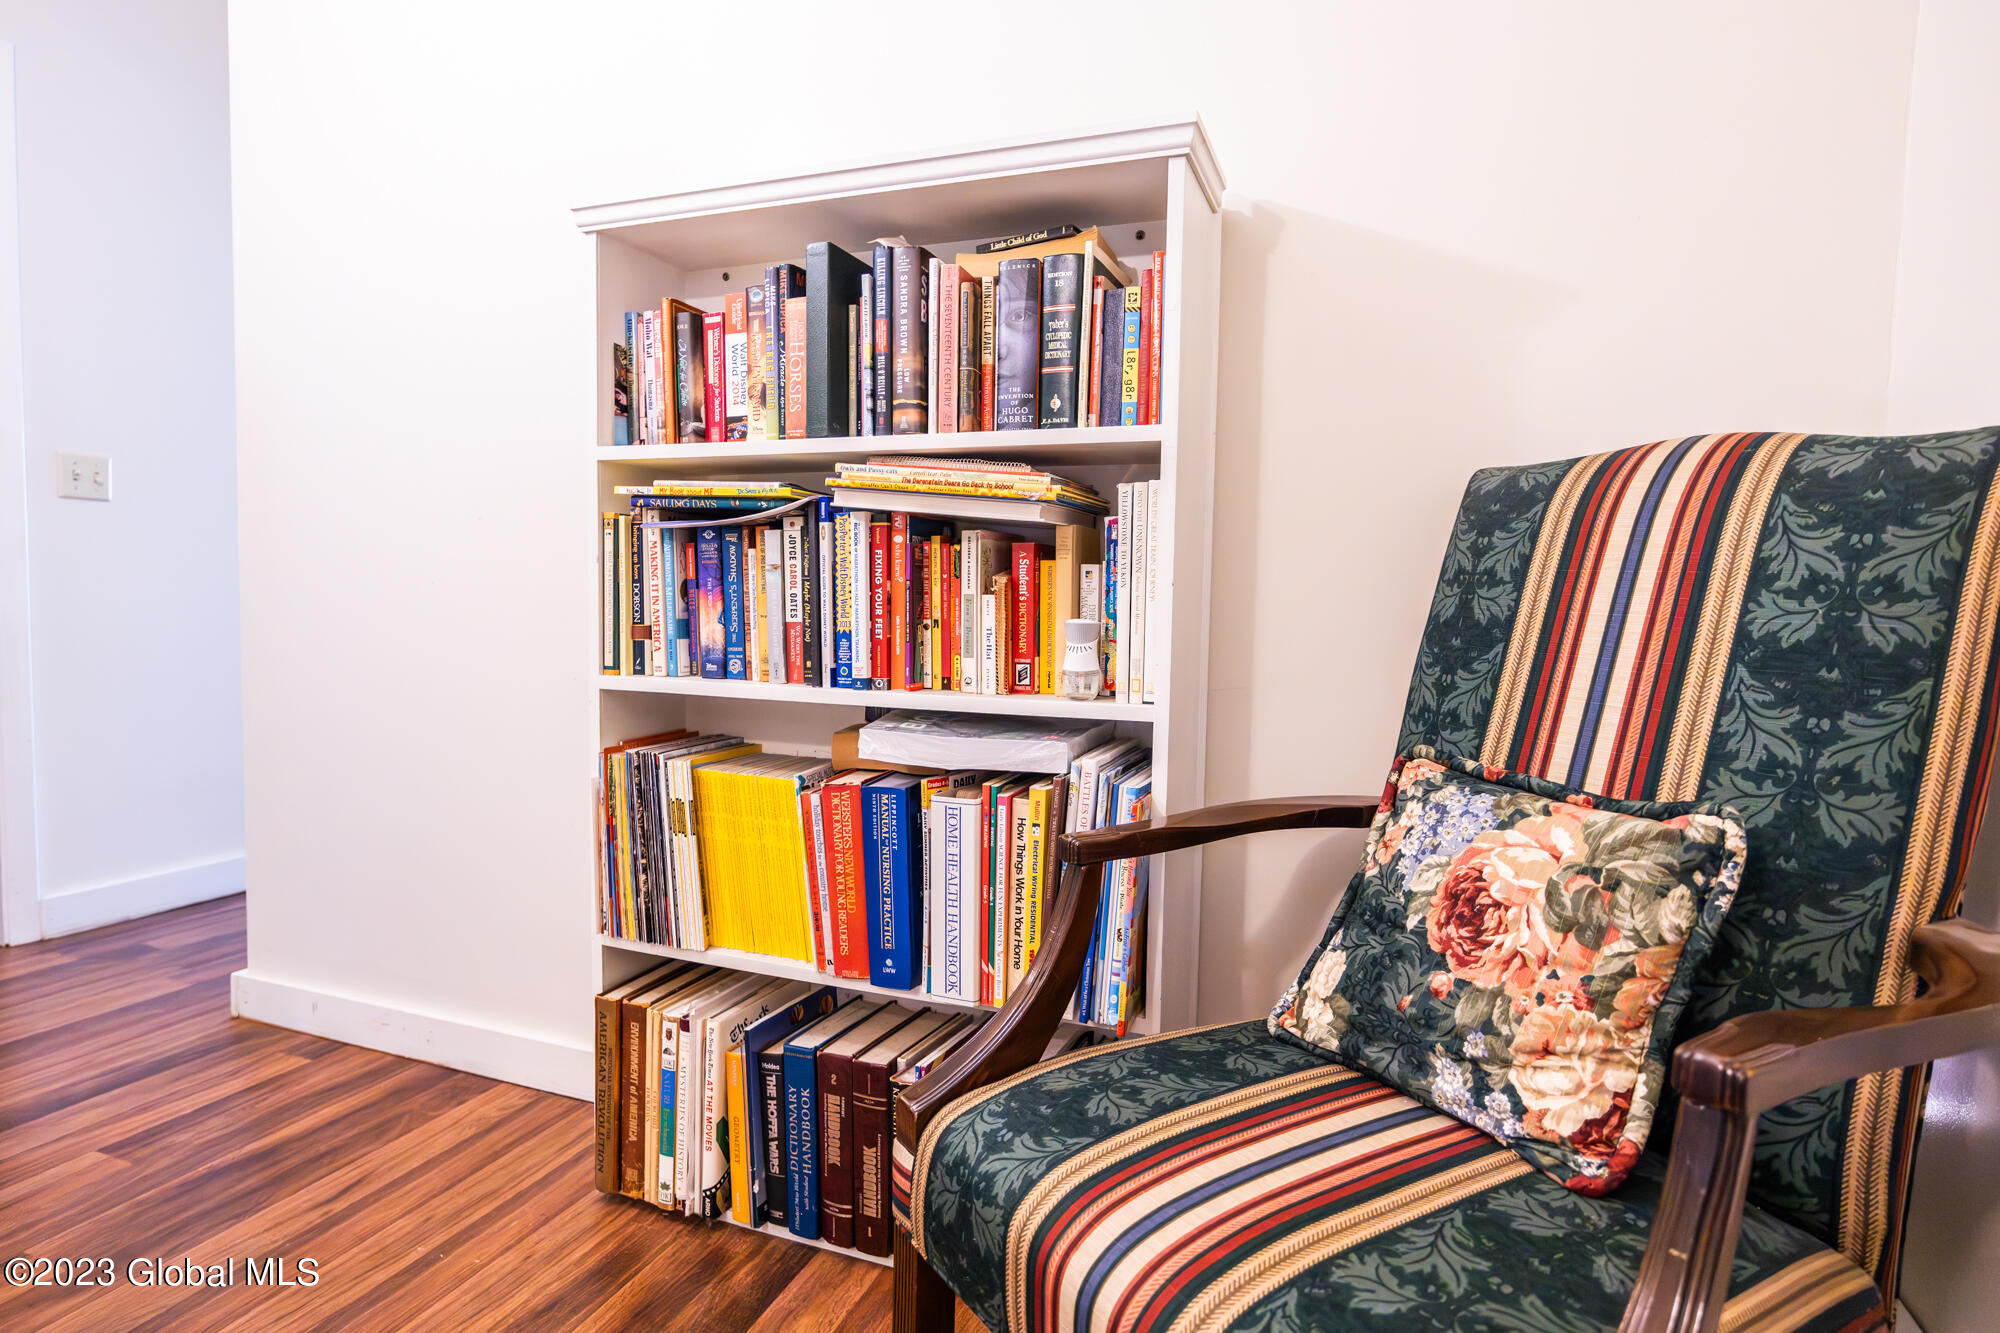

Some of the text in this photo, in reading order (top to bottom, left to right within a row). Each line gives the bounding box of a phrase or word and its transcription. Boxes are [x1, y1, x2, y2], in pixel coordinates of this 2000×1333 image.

[1007, 235, 1025, 246] Child
[1026, 233, 1032, 241] of
[1033, 230, 1047, 240] God
[878, 257, 887, 286] KILLING
[878, 287, 887, 316] LINCOLN
[900, 275, 908, 355] SANDRA BROWN
[983, 281, 993, 356] THINGS FALL APART
[766, 324, 776, 410] THE BIG FIELD
[878, 356, 886, 369] BILL
[943, 284, 953, 408] THE SEVENTEENTH CENTURY
[713, 356, 721, 387] Dictionary
[731, 343, 739, 406] World 2014
[739, 342, 748, 406] Walt Disney
[789, 342, 804, 414] HORSES
[878, 370, 886, 395] O'REILLY
[998, 415, 1034, 424] CABRET
[1002, 407, 1028, 415] HUGO
[650, 499, 718, 508] SAILING DAYS
[704, 488, 714, 496] ME
[912, 478, 943, 486] Berenstain
[944, 479, 960, 487] Bears
[994, 482, 1014, 490] School
[632, 525, 640, 580] bringing up boys
[728, 545, 737, 582] SHADOW
[1120, 491, 1129, 588] YELLOWSTONE TO YUKON
[1135, 524, 1143, 573] UNKNOWN
[789, 535, 798, 619] JOYCE CAROL OATES
[838, 518, 850, 619] PassPorter's Walt Disney World
[1019, 559, 1030, 601] Student's
[633, 582, 641, 623] DOBSON
[650, 540, 662, 653] MAKING IT IN AMERICA
[729, 585, 738, 632] SERPENT'S
[804, 602, 812, 626] (Maybe
[874, 549, 883, 640] FIXING YOUR FEET
[804, 627, 812, 643] Not)
[1018, 603, 1027, 655] DICTIONARY
[953, 774, 976, 789] DAILY
[1080, 772, 1093, 831] BATTLES OF
[813, 805, 823, 828] holiday
[880, 794, 890, 839] MANUAL
[815, 829, 824, 854] touches
[841, 790, 857, 913] WEBSTER'S NEW WORLD
[1031, 840, 1039, 873] Electrical
[818, 868, 828, 893] country
[831, 792, 849, 956] DICTIONARY FOR YOUNG READERS
[881, 845, 891, 895] NURSING
[1013, 818, 1026, 970] How Things Work in Your Home
[1030, 875, 1038, 899] Wiring
[883, 897, 893, 949] PRACTICE
[947, 806, 959, 994] HOME HEALTH HANDBOOK
[1029, 900, 1037, 944] RESIDENTIAL
[882, 966, 896, 974] LWW
[597, 1011, 608, 1173] AMERICAN REVOLUTION
[628, 1021, 639, 1141] ENVIRONMENT of AMERICA
[706, 1080, 713, 1092] AT
[830, 1073, 837, 1085] 2
[677, 1065, 687, 1183] MYSTERIES OF HISTORY
[705, 1116, 713, 1152] MOVIES
[733, 1116, 741, 1163] GEOMETRY
[766, 1075, 779, 1174] THE HOFFA WARS
[788, 1084, 799, 1170] DICTIONARY
[800, 1087, 812, 1174] HANDBOOK
[827, 1093, 842, 1167] HANDBOOK
[863, 1145, 877, 1218] HANDBOOK
